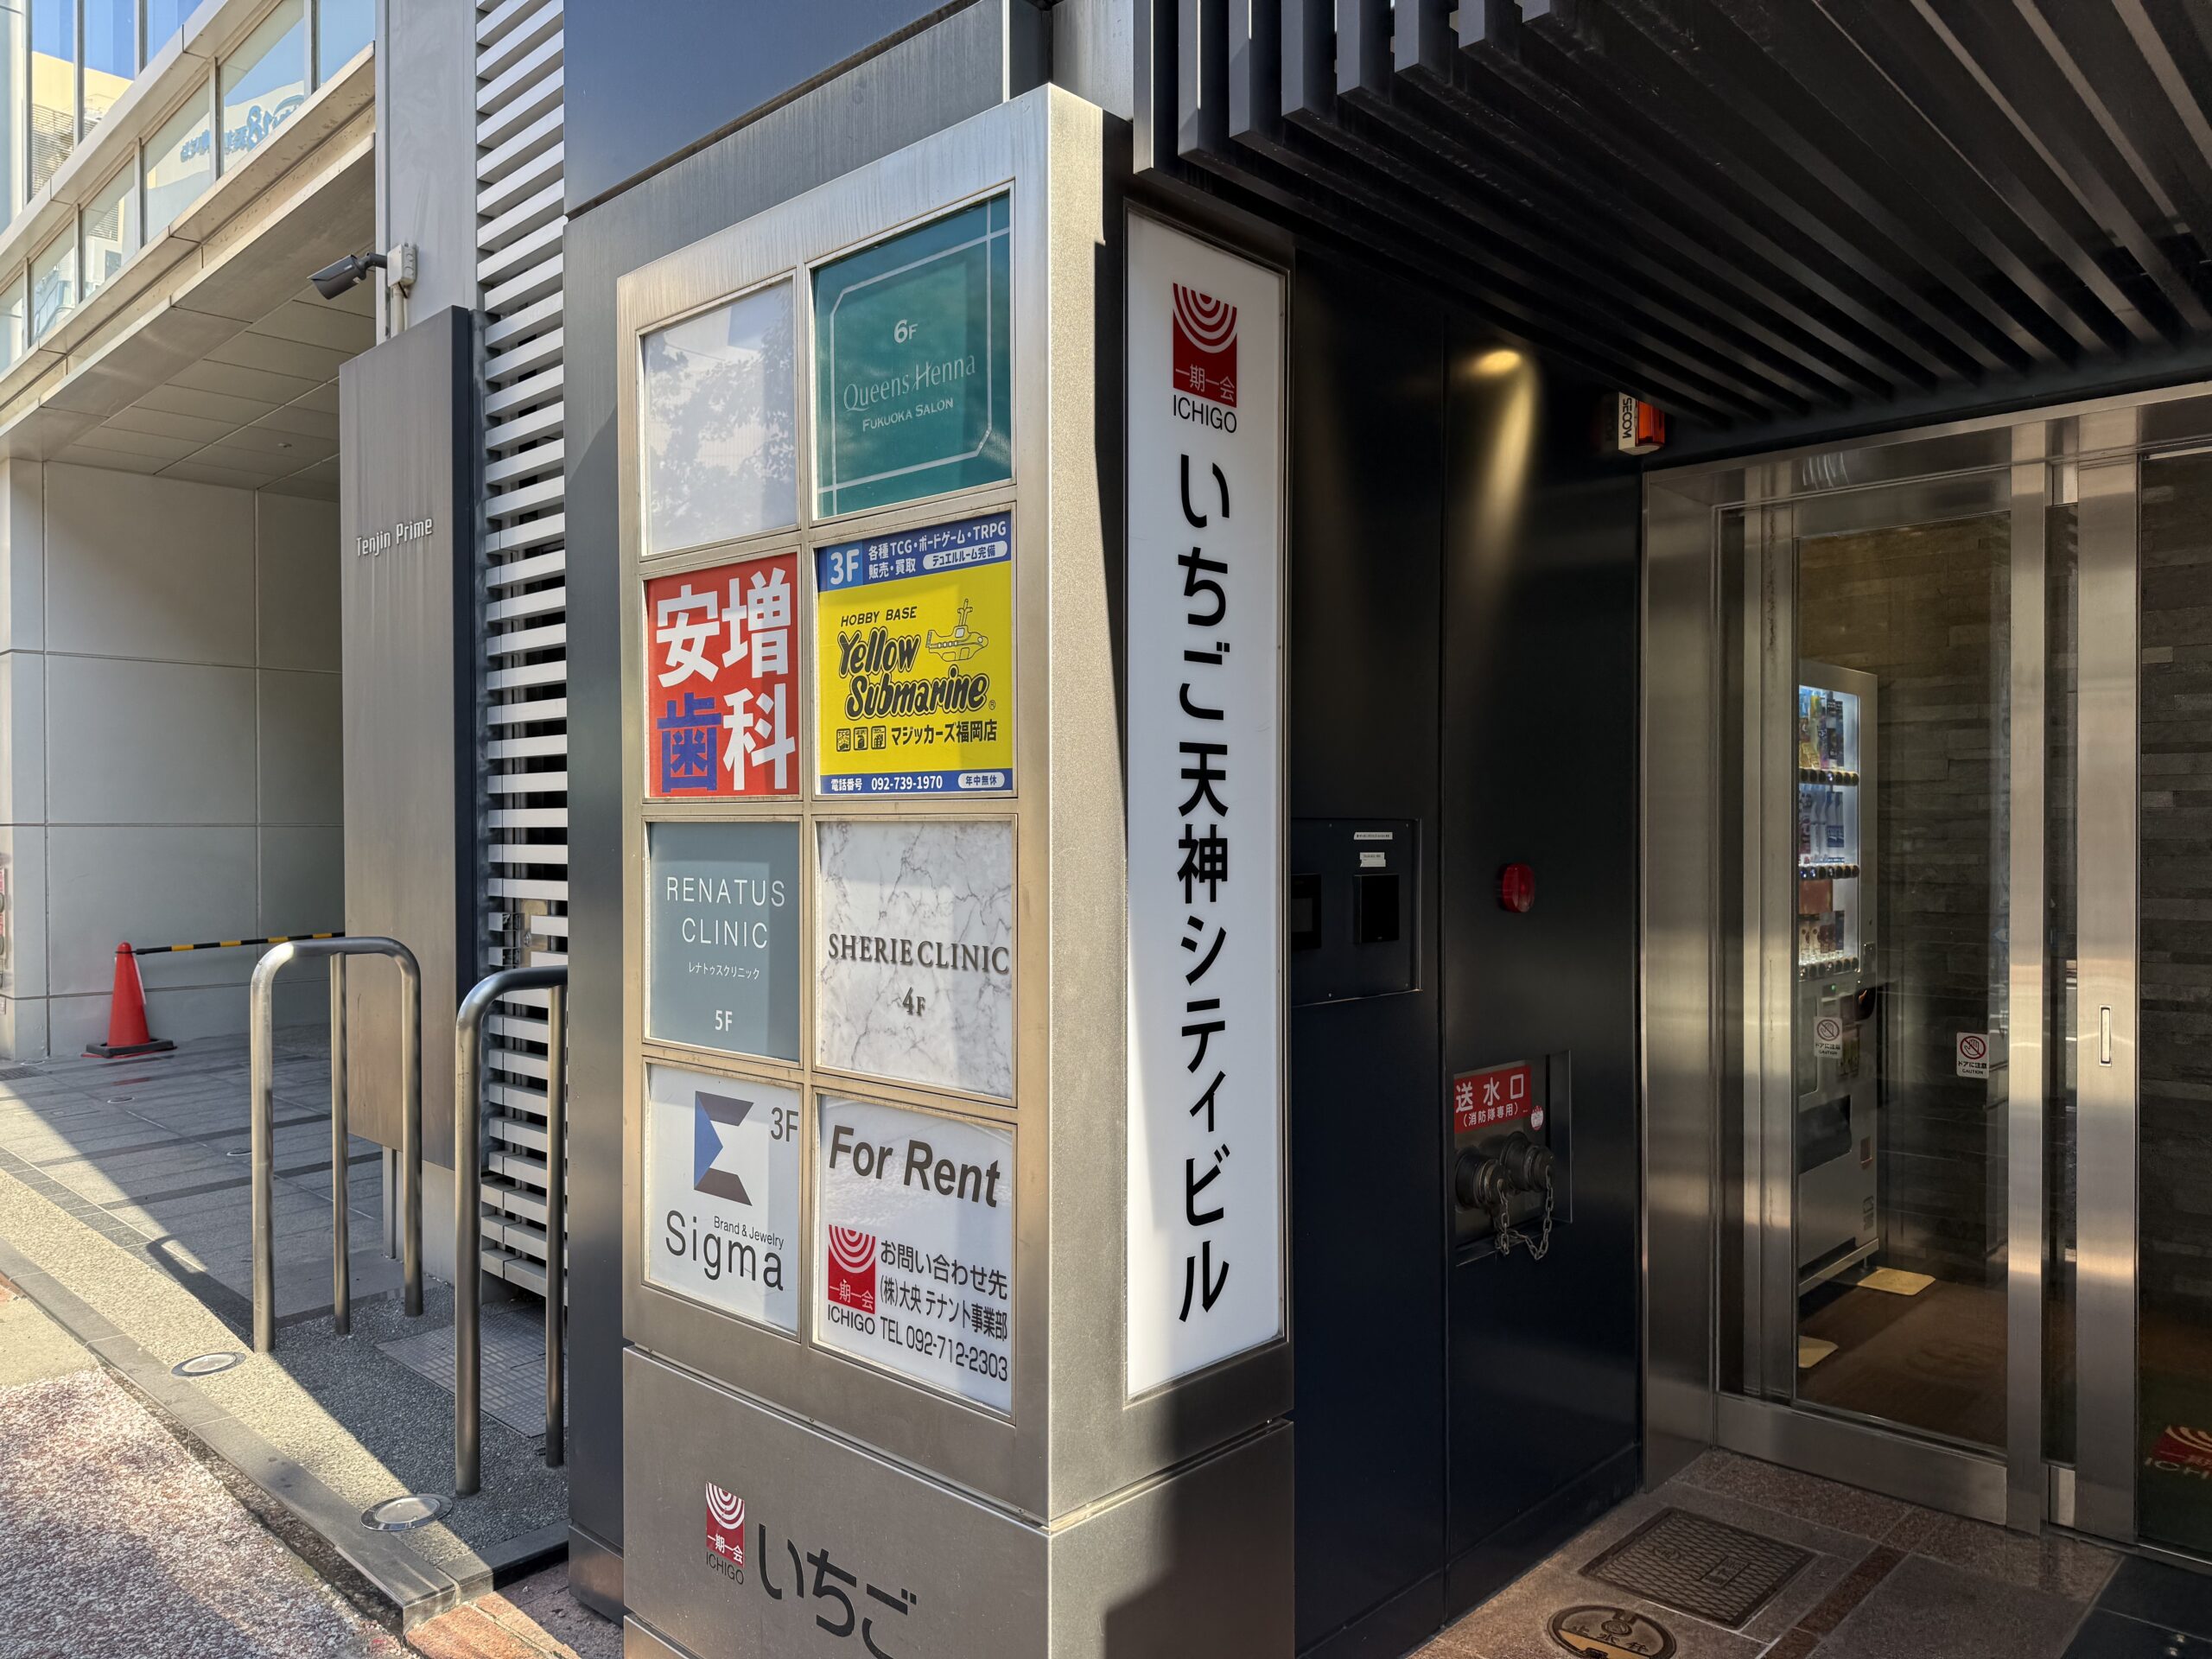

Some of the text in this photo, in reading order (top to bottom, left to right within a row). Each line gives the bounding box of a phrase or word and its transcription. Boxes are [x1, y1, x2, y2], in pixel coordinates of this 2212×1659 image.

[893, 319, 918, 343] 6F
[843, 354, 976, 413] Queens Henna
[1175, 364, 1236, 403] 一期一会
[862, 397, 955, 432] FUKUOKA SALON
[1173, 394, 1237, 433] ICHIGO
[1622, 397, 1632, 439] SECOM
[356, 518, 433, 557] Tenjin Prime
[830, 549, 860, 585] 3F
[868, 557, 917, 581] 販売・買取
[656, 567, 791, 688] 安増
[841, 606, 918, 628] HOBBY BASE
[837, 626, 921, 678] Yellow
[844, 664, 989, 721] Submarine
[656, 683, 796, 793] 歯科
[891, 719, 998, 747] マジッカーズ福岡店
[830, 775, 944, 791] 電話番号 092-739-1970
[965, 775, 997, 786] 年中無休
[666, 876, 785, 907] RENATUS
[1177, 451, 1230, 1323] いちご天神シティビル
[682, 918, 768, 949] CLINIC
[689, 961, 760, 980] レナトゥスクリニック
[902, 987, 926, 1017] 4F
[715, 1009, 733, 1032] 5F
[1455, 1073, 1524, 1113] 送水口
[770, 1107, 798, 1141] 3F
[829, 1125, 1000, 1208] For Rent
[714, 1216, 785, 1249] Brand & Jewelry
[665, 1210, 784, 1291] Sigma
[880, 1240, 1007, 1300] お問い合わせ先
[829, 1279, 874, 1311] 一期一会
[828, 1304, 875, 1335] ICHIGO
[880, 1316, 1007, 1382] TEL 092-712-2303
[707, 1533, 743, 1565] 一期一会
[705, 1551, 745, 1585] ICHIGO
[758, 1522, 918, 1659] いちご
